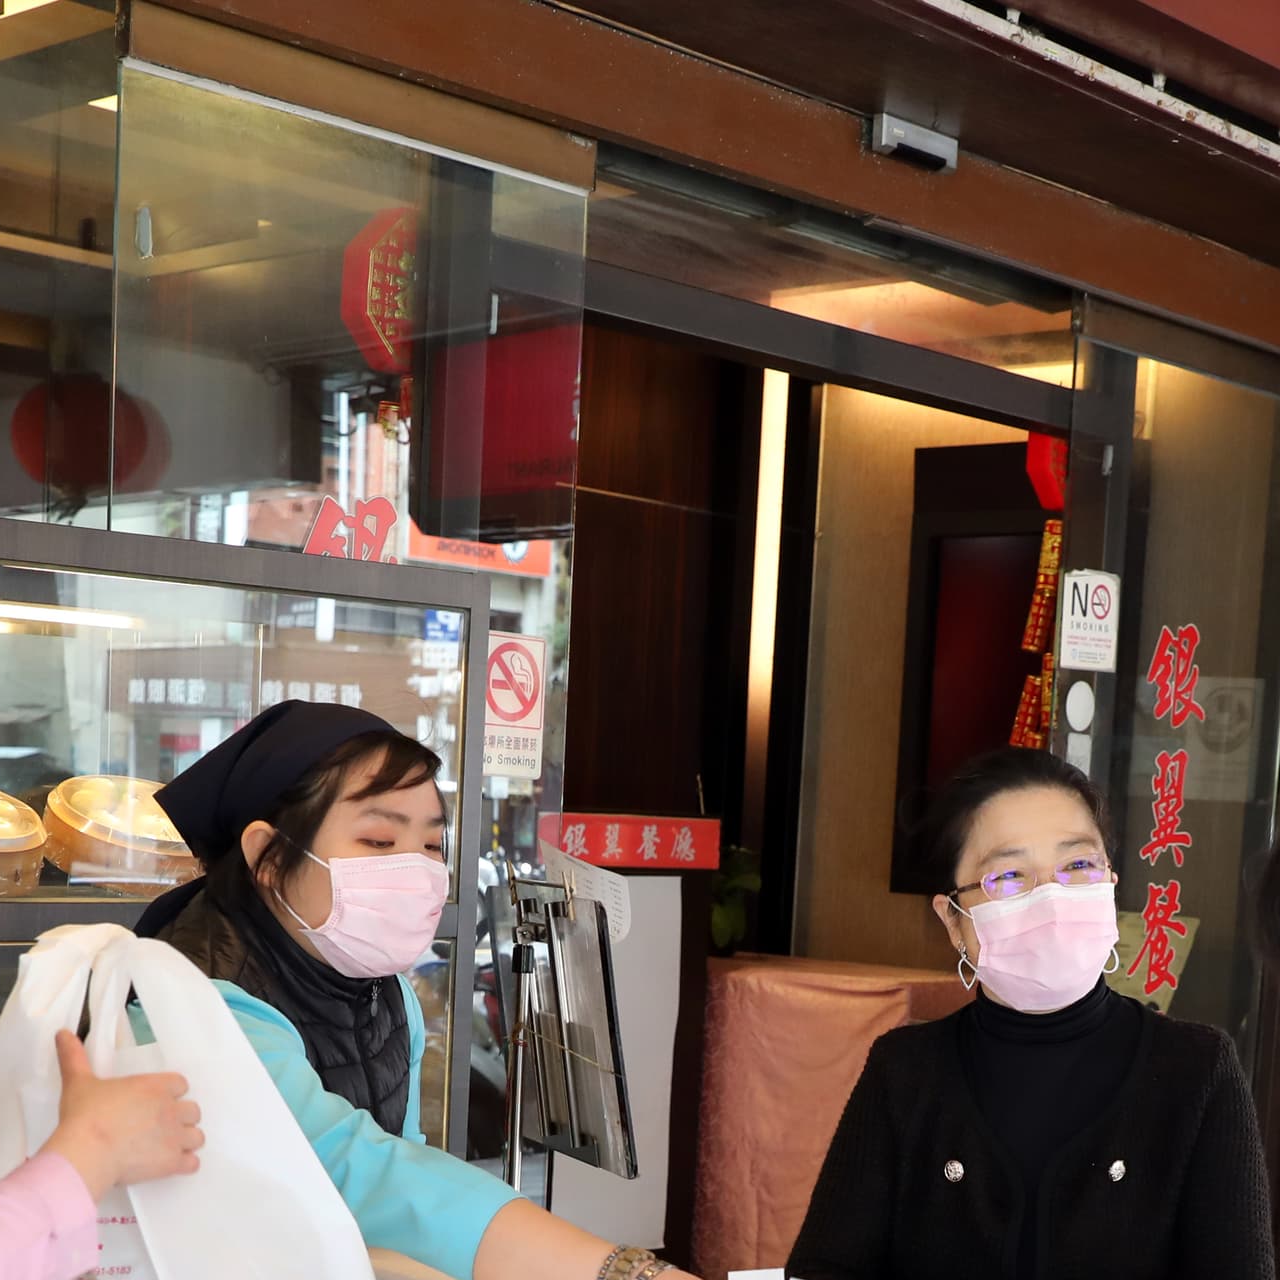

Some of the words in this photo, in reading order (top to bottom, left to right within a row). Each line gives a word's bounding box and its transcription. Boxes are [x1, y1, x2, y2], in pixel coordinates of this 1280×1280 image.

[497, 754, 536, 769] Smoking
[1127, 624, 1206, 996] 銀翼餐
[562, 822, 698, 862] 銀翼餐廳
